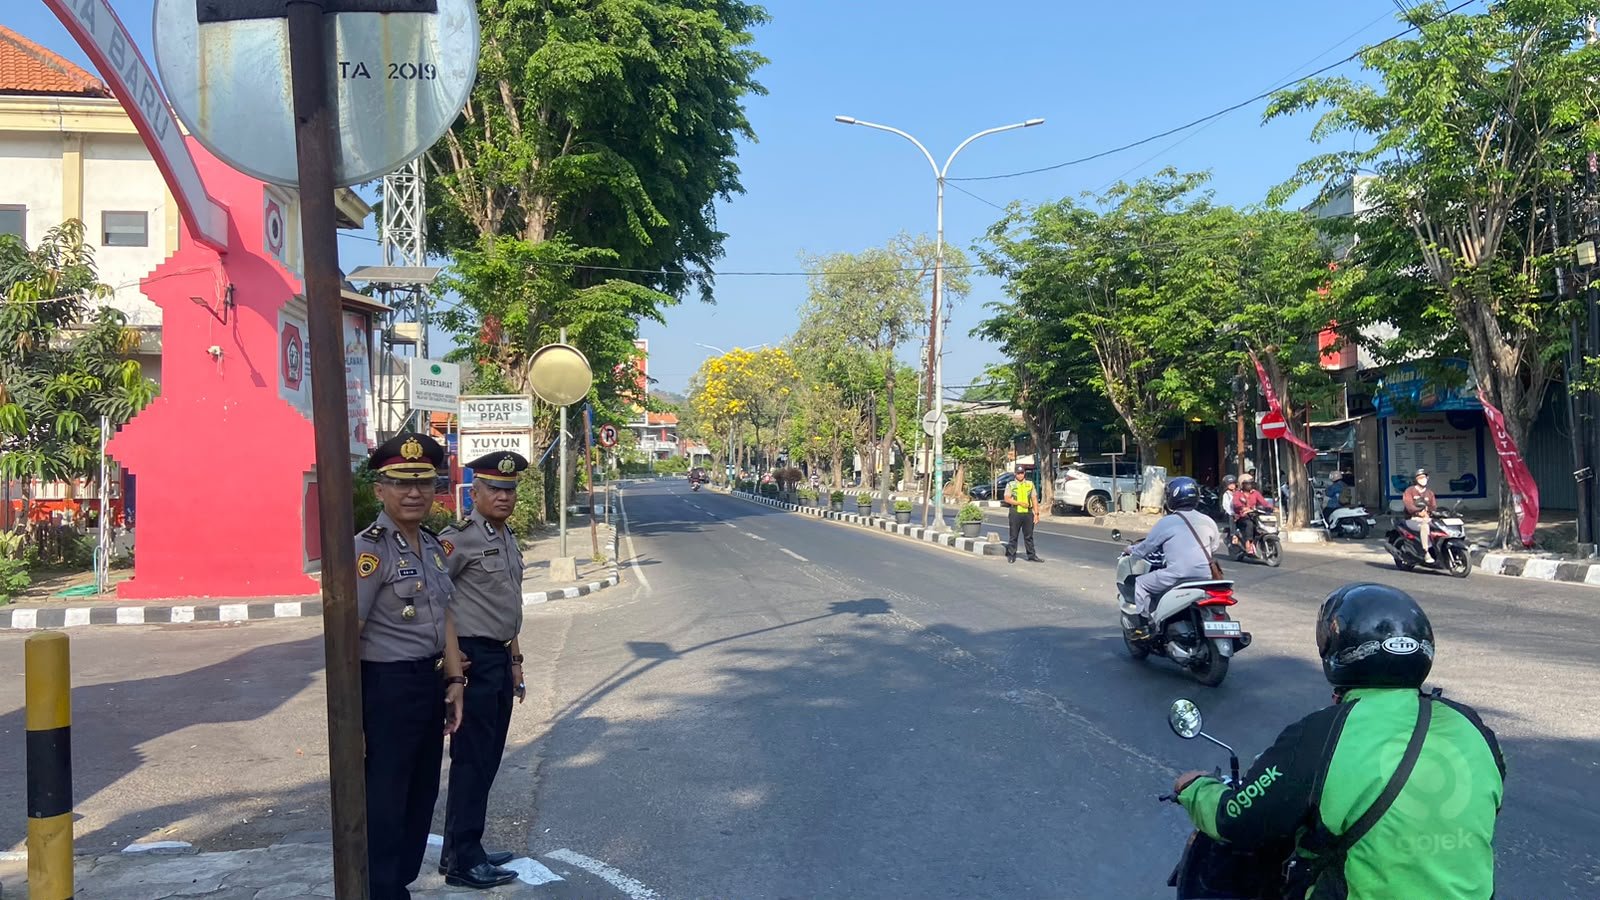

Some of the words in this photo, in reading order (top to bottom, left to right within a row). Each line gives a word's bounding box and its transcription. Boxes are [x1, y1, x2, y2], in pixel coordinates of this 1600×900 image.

[388, 63, 436, 80] 2019
[109, 25, 169, 141] BARU
[420, 378, 453, 390] SEKRETARIAT
[468, 403, 522, 412] NOTARIS
[480, 412, 511, 421] PPAT
[472, 438, 520, 448] YUYUN
[1236, 765, 1283, 808] gojek
[1395, 828, 1474, 858] gojek
